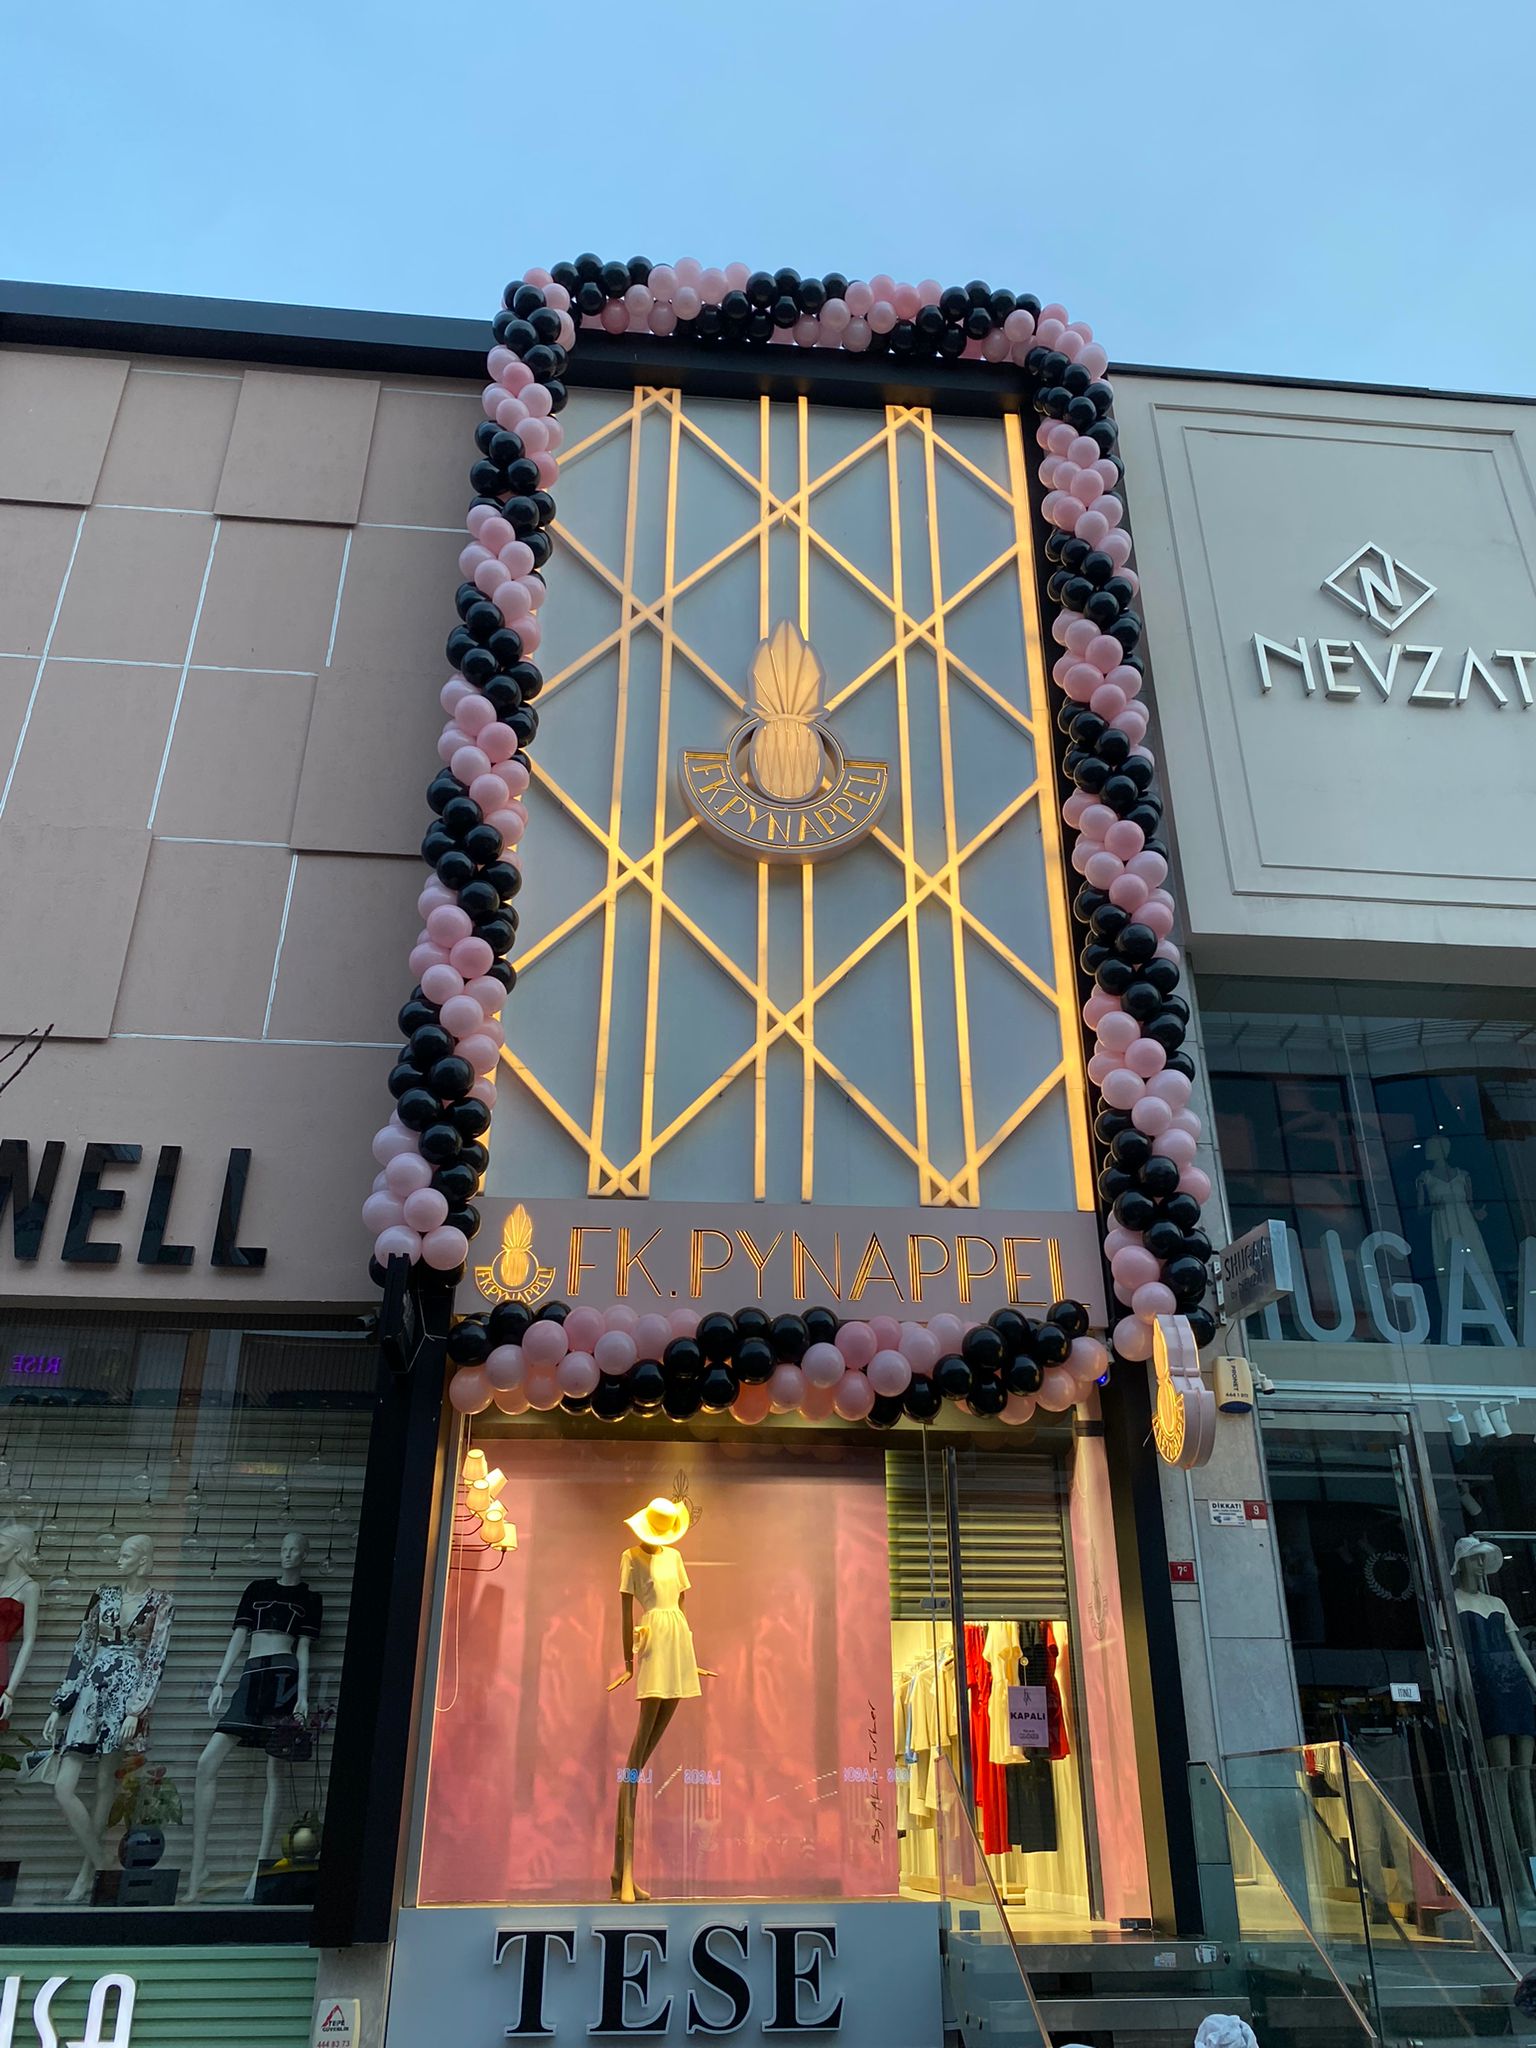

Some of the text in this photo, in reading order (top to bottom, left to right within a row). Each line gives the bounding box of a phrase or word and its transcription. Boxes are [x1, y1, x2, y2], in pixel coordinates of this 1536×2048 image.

[1250, 632, 1536, 710] NEVZAT
[1253, 1505, 1260, 1515] 9
[1010, 1712, 1046, 1720] KAPALI
[492, 1919, 845, 2038] TESE
